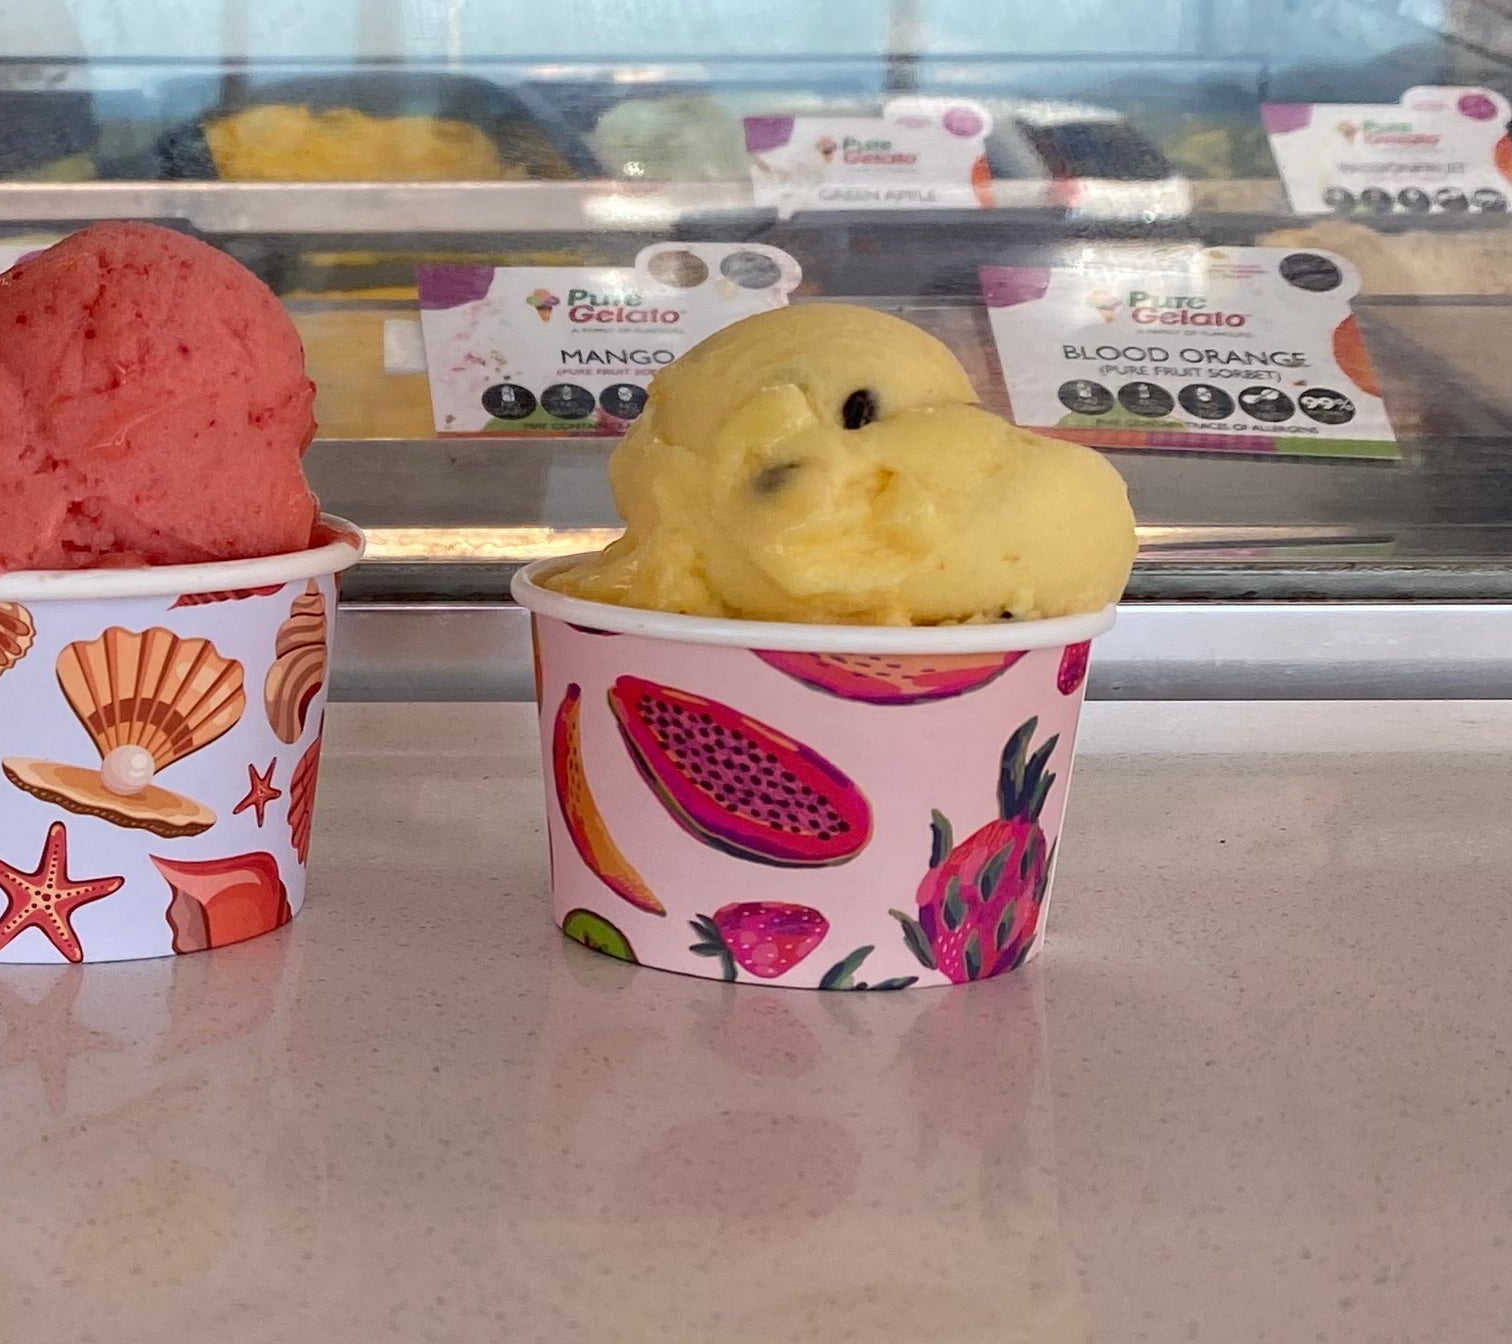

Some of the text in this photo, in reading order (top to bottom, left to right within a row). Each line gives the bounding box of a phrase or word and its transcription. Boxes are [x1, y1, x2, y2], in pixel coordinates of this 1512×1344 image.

[567, 288, 643, 307] Pure
[1129, 290, 1207, 309] Pure
[568, 304, 680, 325] Gelato
[1131, 306, 1247, 328] Gelato
[560, 349, 675, 365] MANGO
[1062, 344, 1311, 368] BLOOD ORANGE
[1099, 364, 1282, 384] (PURE FRUIT SORBET)
